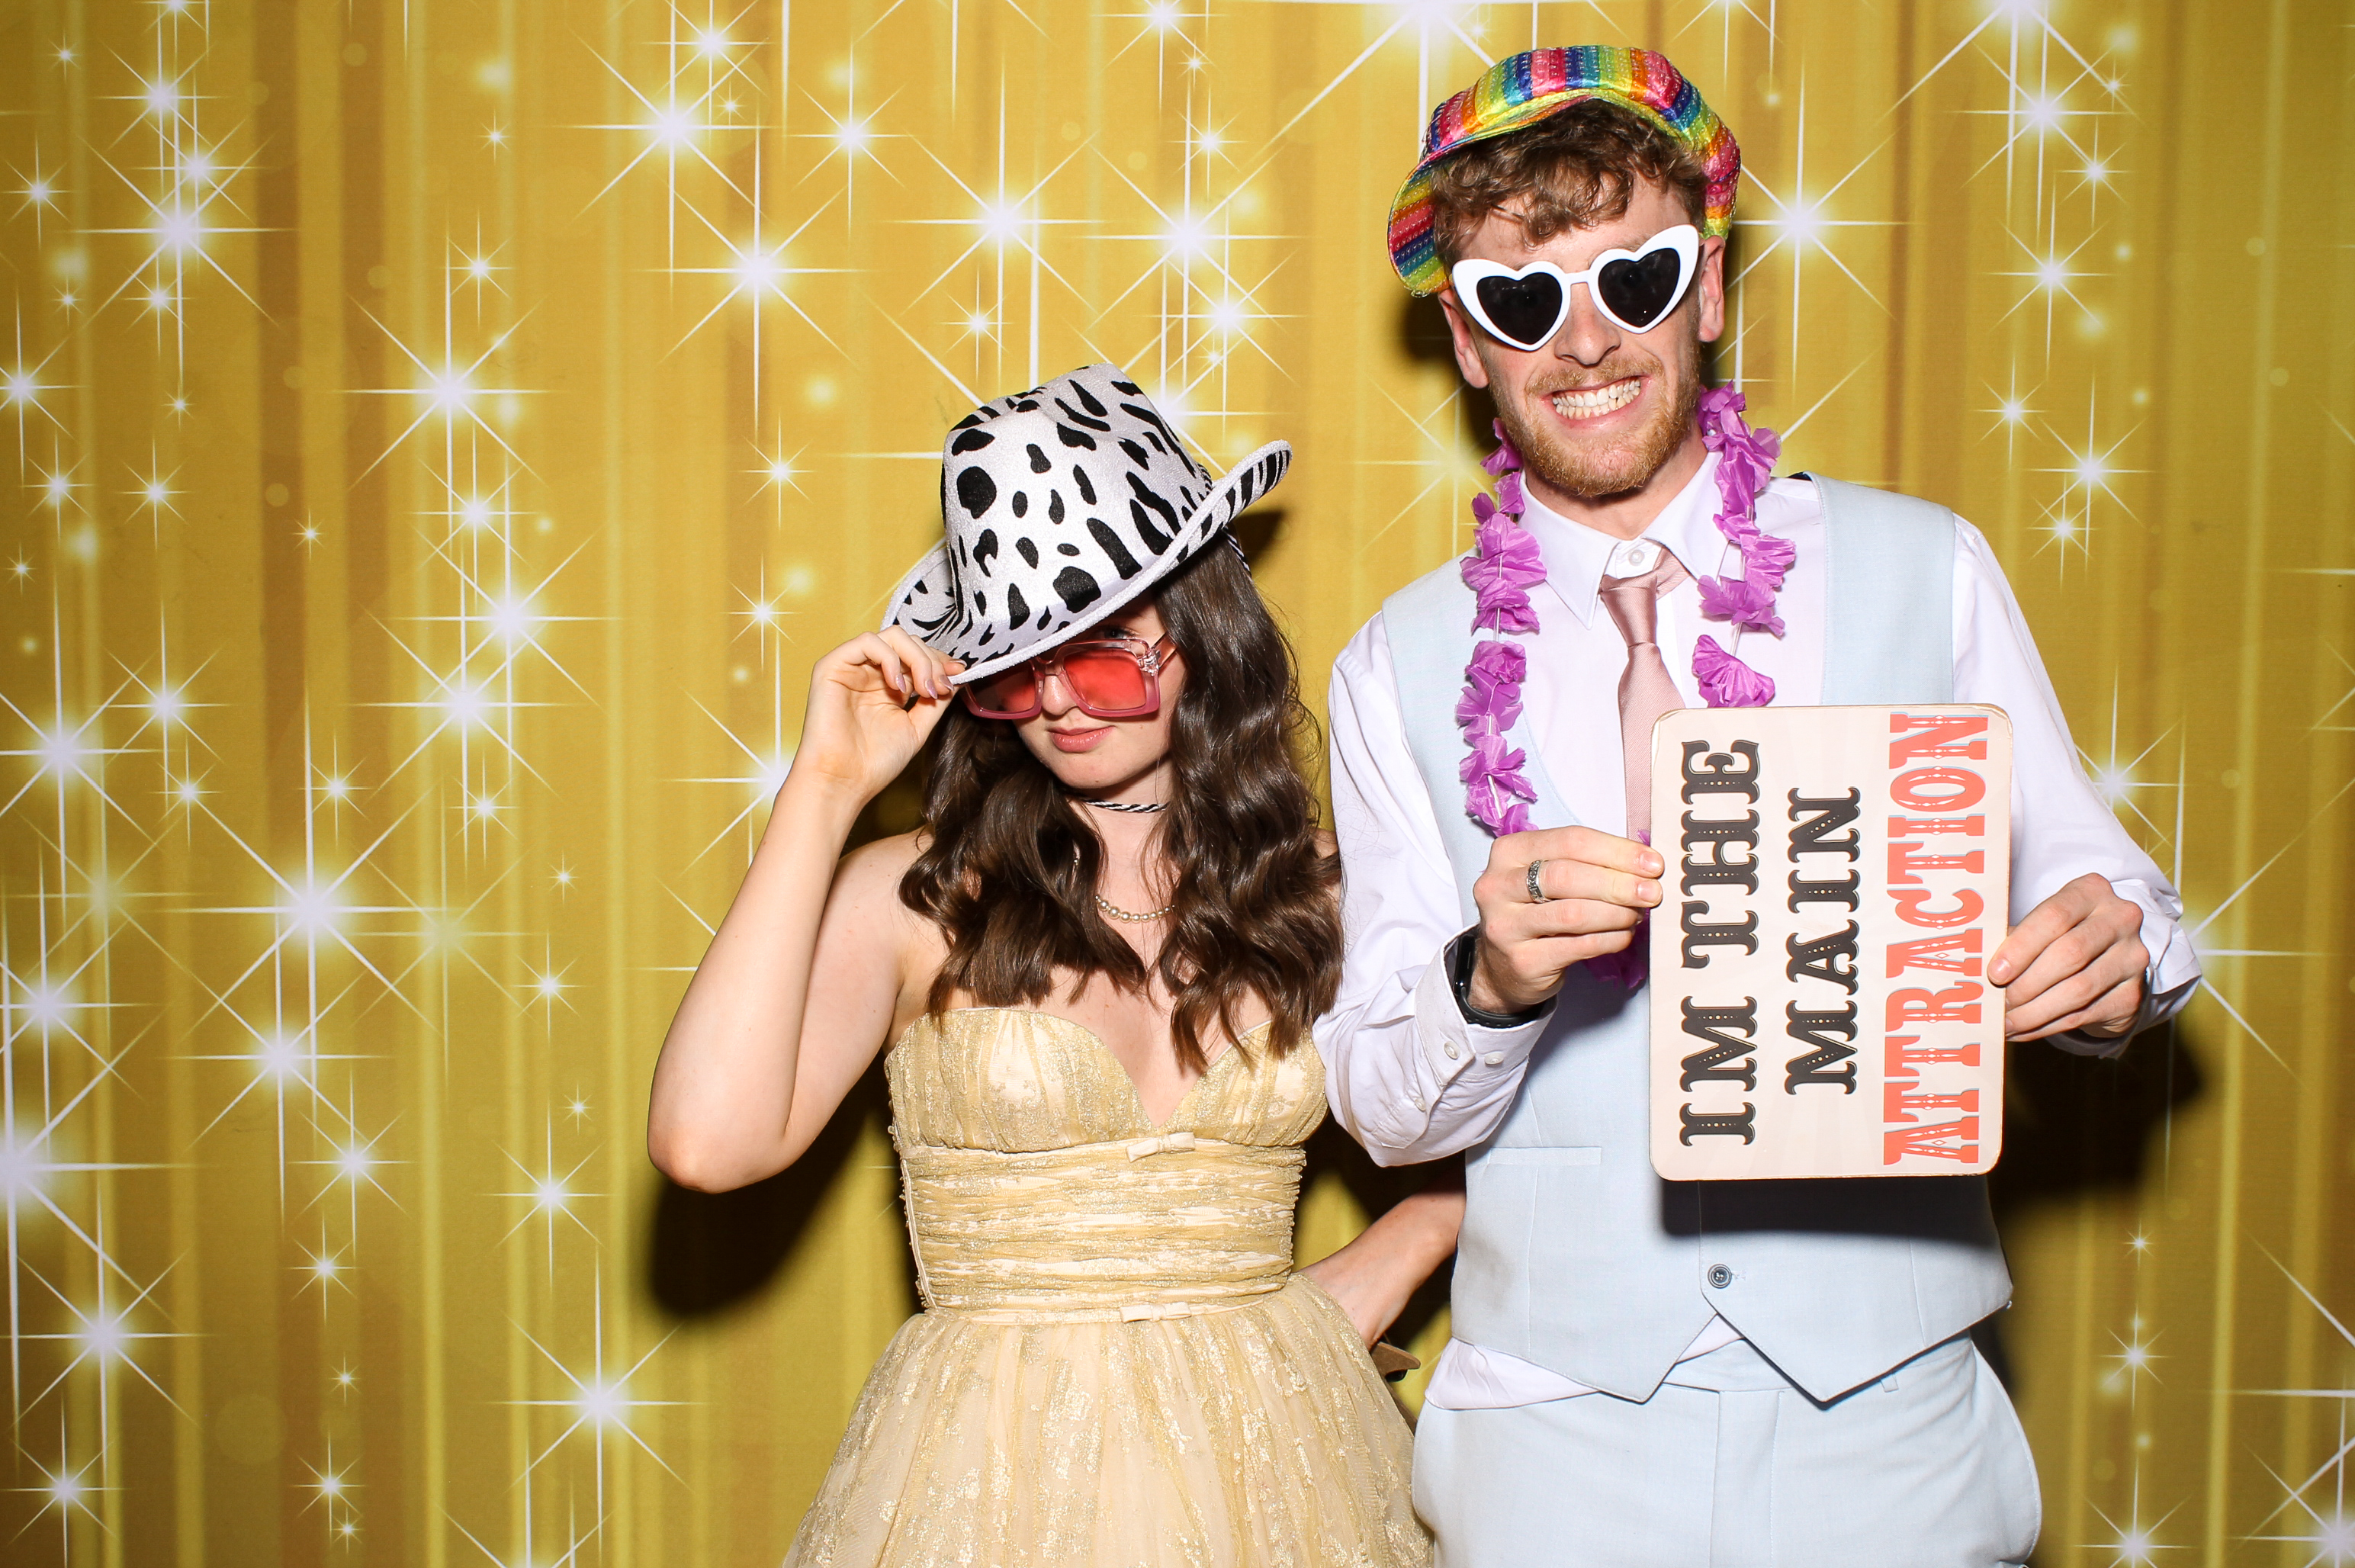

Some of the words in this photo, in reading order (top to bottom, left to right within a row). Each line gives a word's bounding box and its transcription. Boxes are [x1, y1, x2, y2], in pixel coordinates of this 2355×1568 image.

[1680, 739, 1760, 969] THE
[1784, 786, 1861, 1095] MAIN
[1883, 712, 1989, 1165] ATTRACTION
[1679, 995, 1758, 1146] IM
